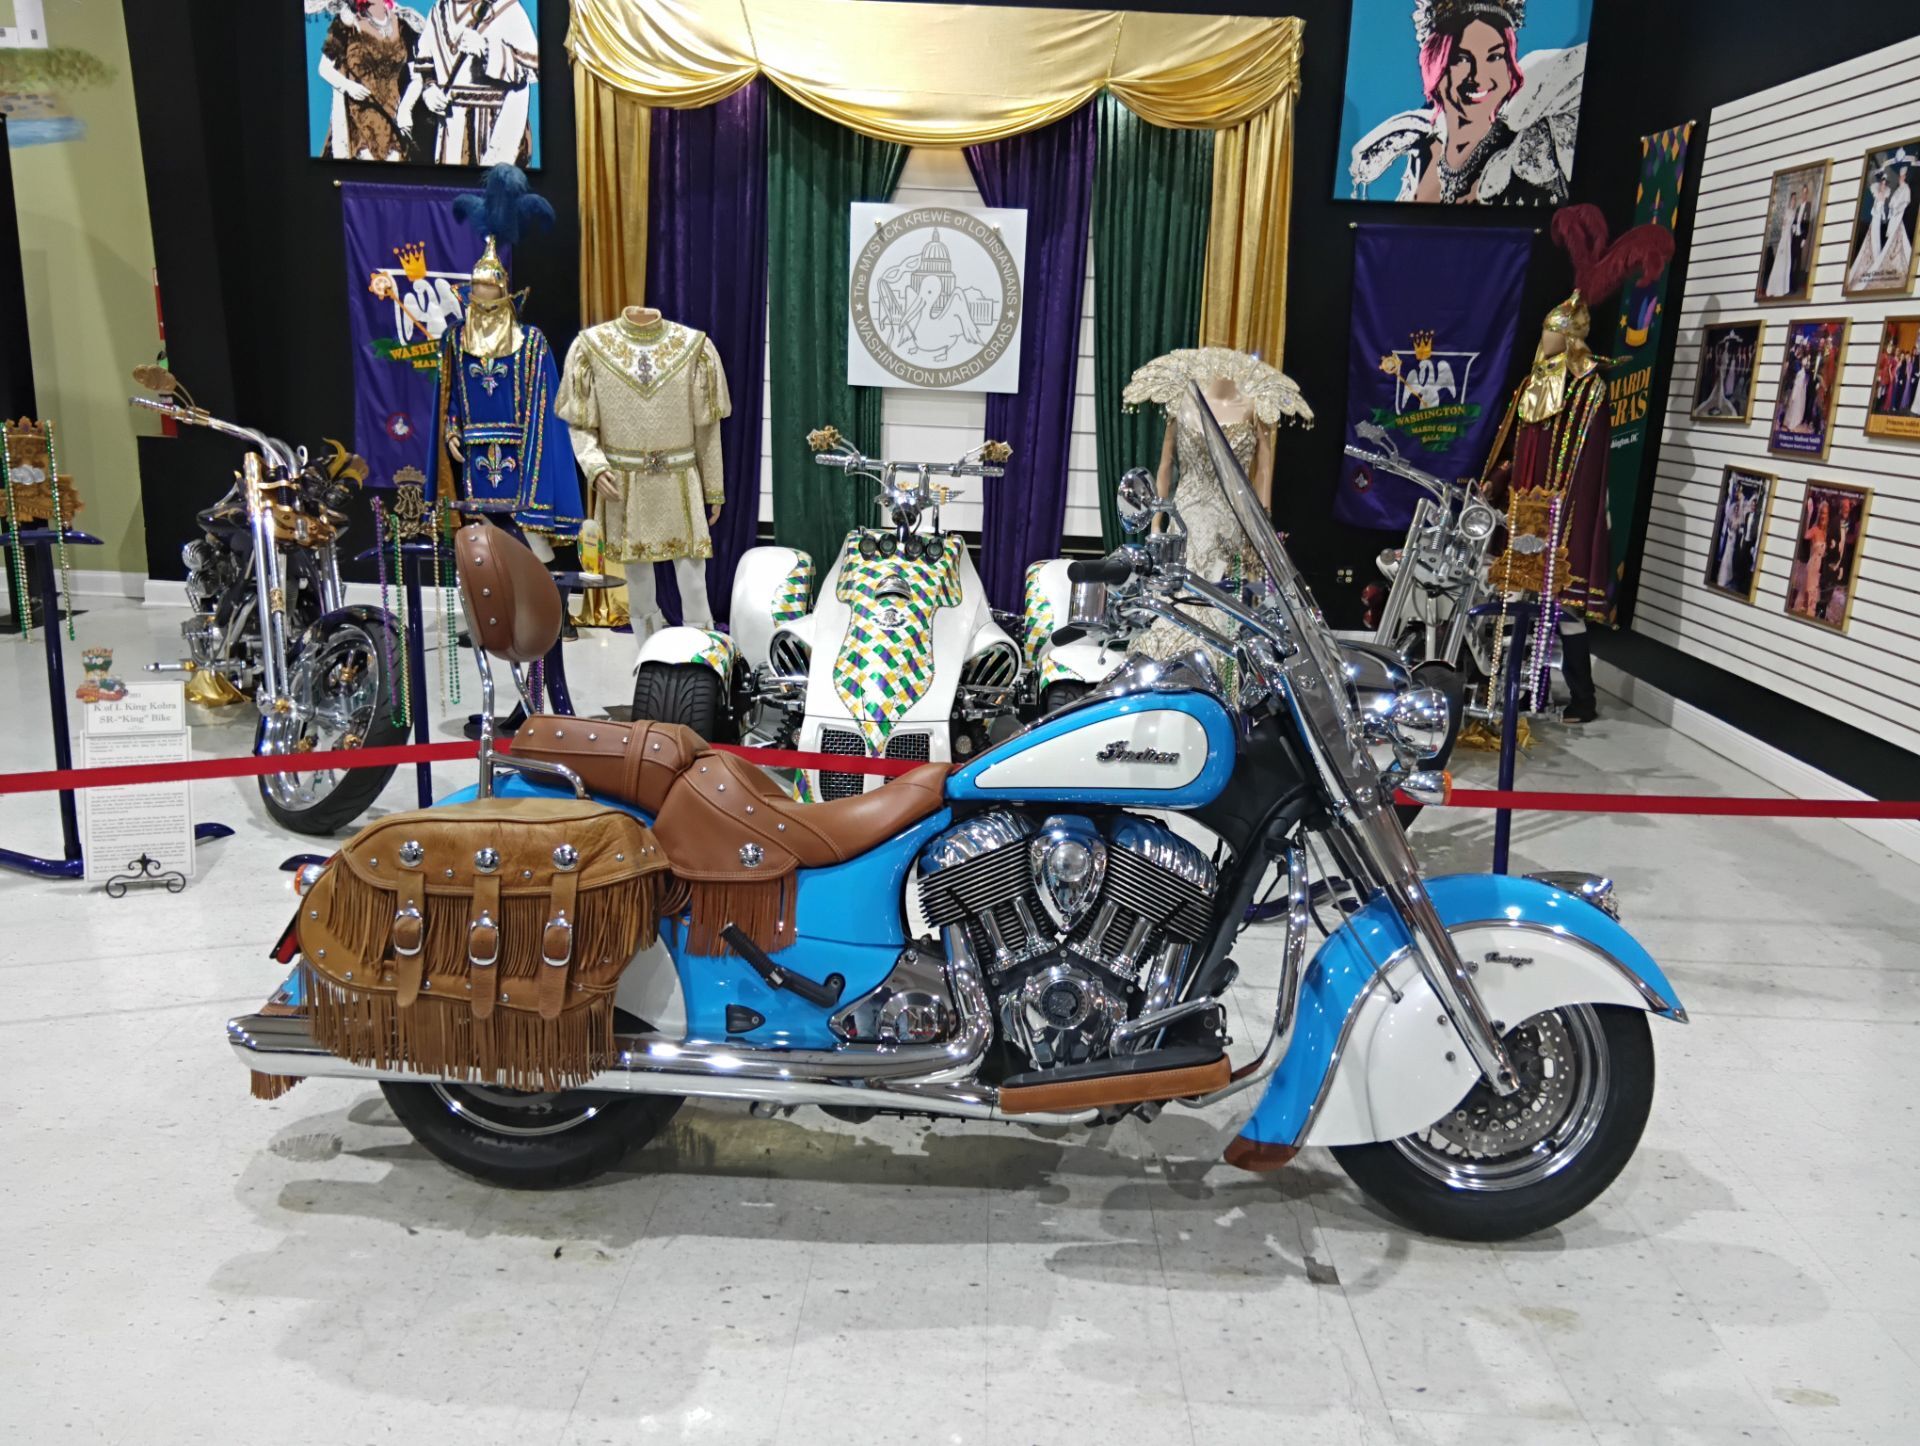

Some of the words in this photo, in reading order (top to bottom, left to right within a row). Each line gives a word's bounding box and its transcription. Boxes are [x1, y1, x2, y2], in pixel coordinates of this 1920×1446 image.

[854, 274, 867, 297] The
[863, 222, 904, 274] MYSTICK
[903, 211, 950, 228] KREWE
[954, 216, 966, 226] of
[968, 220, 1017, 305] LOUISIANIANS
[856, 315, 935, 384] WASHINGTON
[939, 359, 984, 384] MARDI
[984, 323, 1012, 363] GRAS
[1610, 366, 1652, 401] MARDI
[1395, 406, 1465, 426] WASHINGTON
[93, 704, 102, 712] K
[103, 704, 112, 712] of
[125, 703, 147, 712] King
[149, 702, 176, 710] Kobra
[151, 712, 171, 721] Bike
[1097, 740, 1180, 765] Indian
